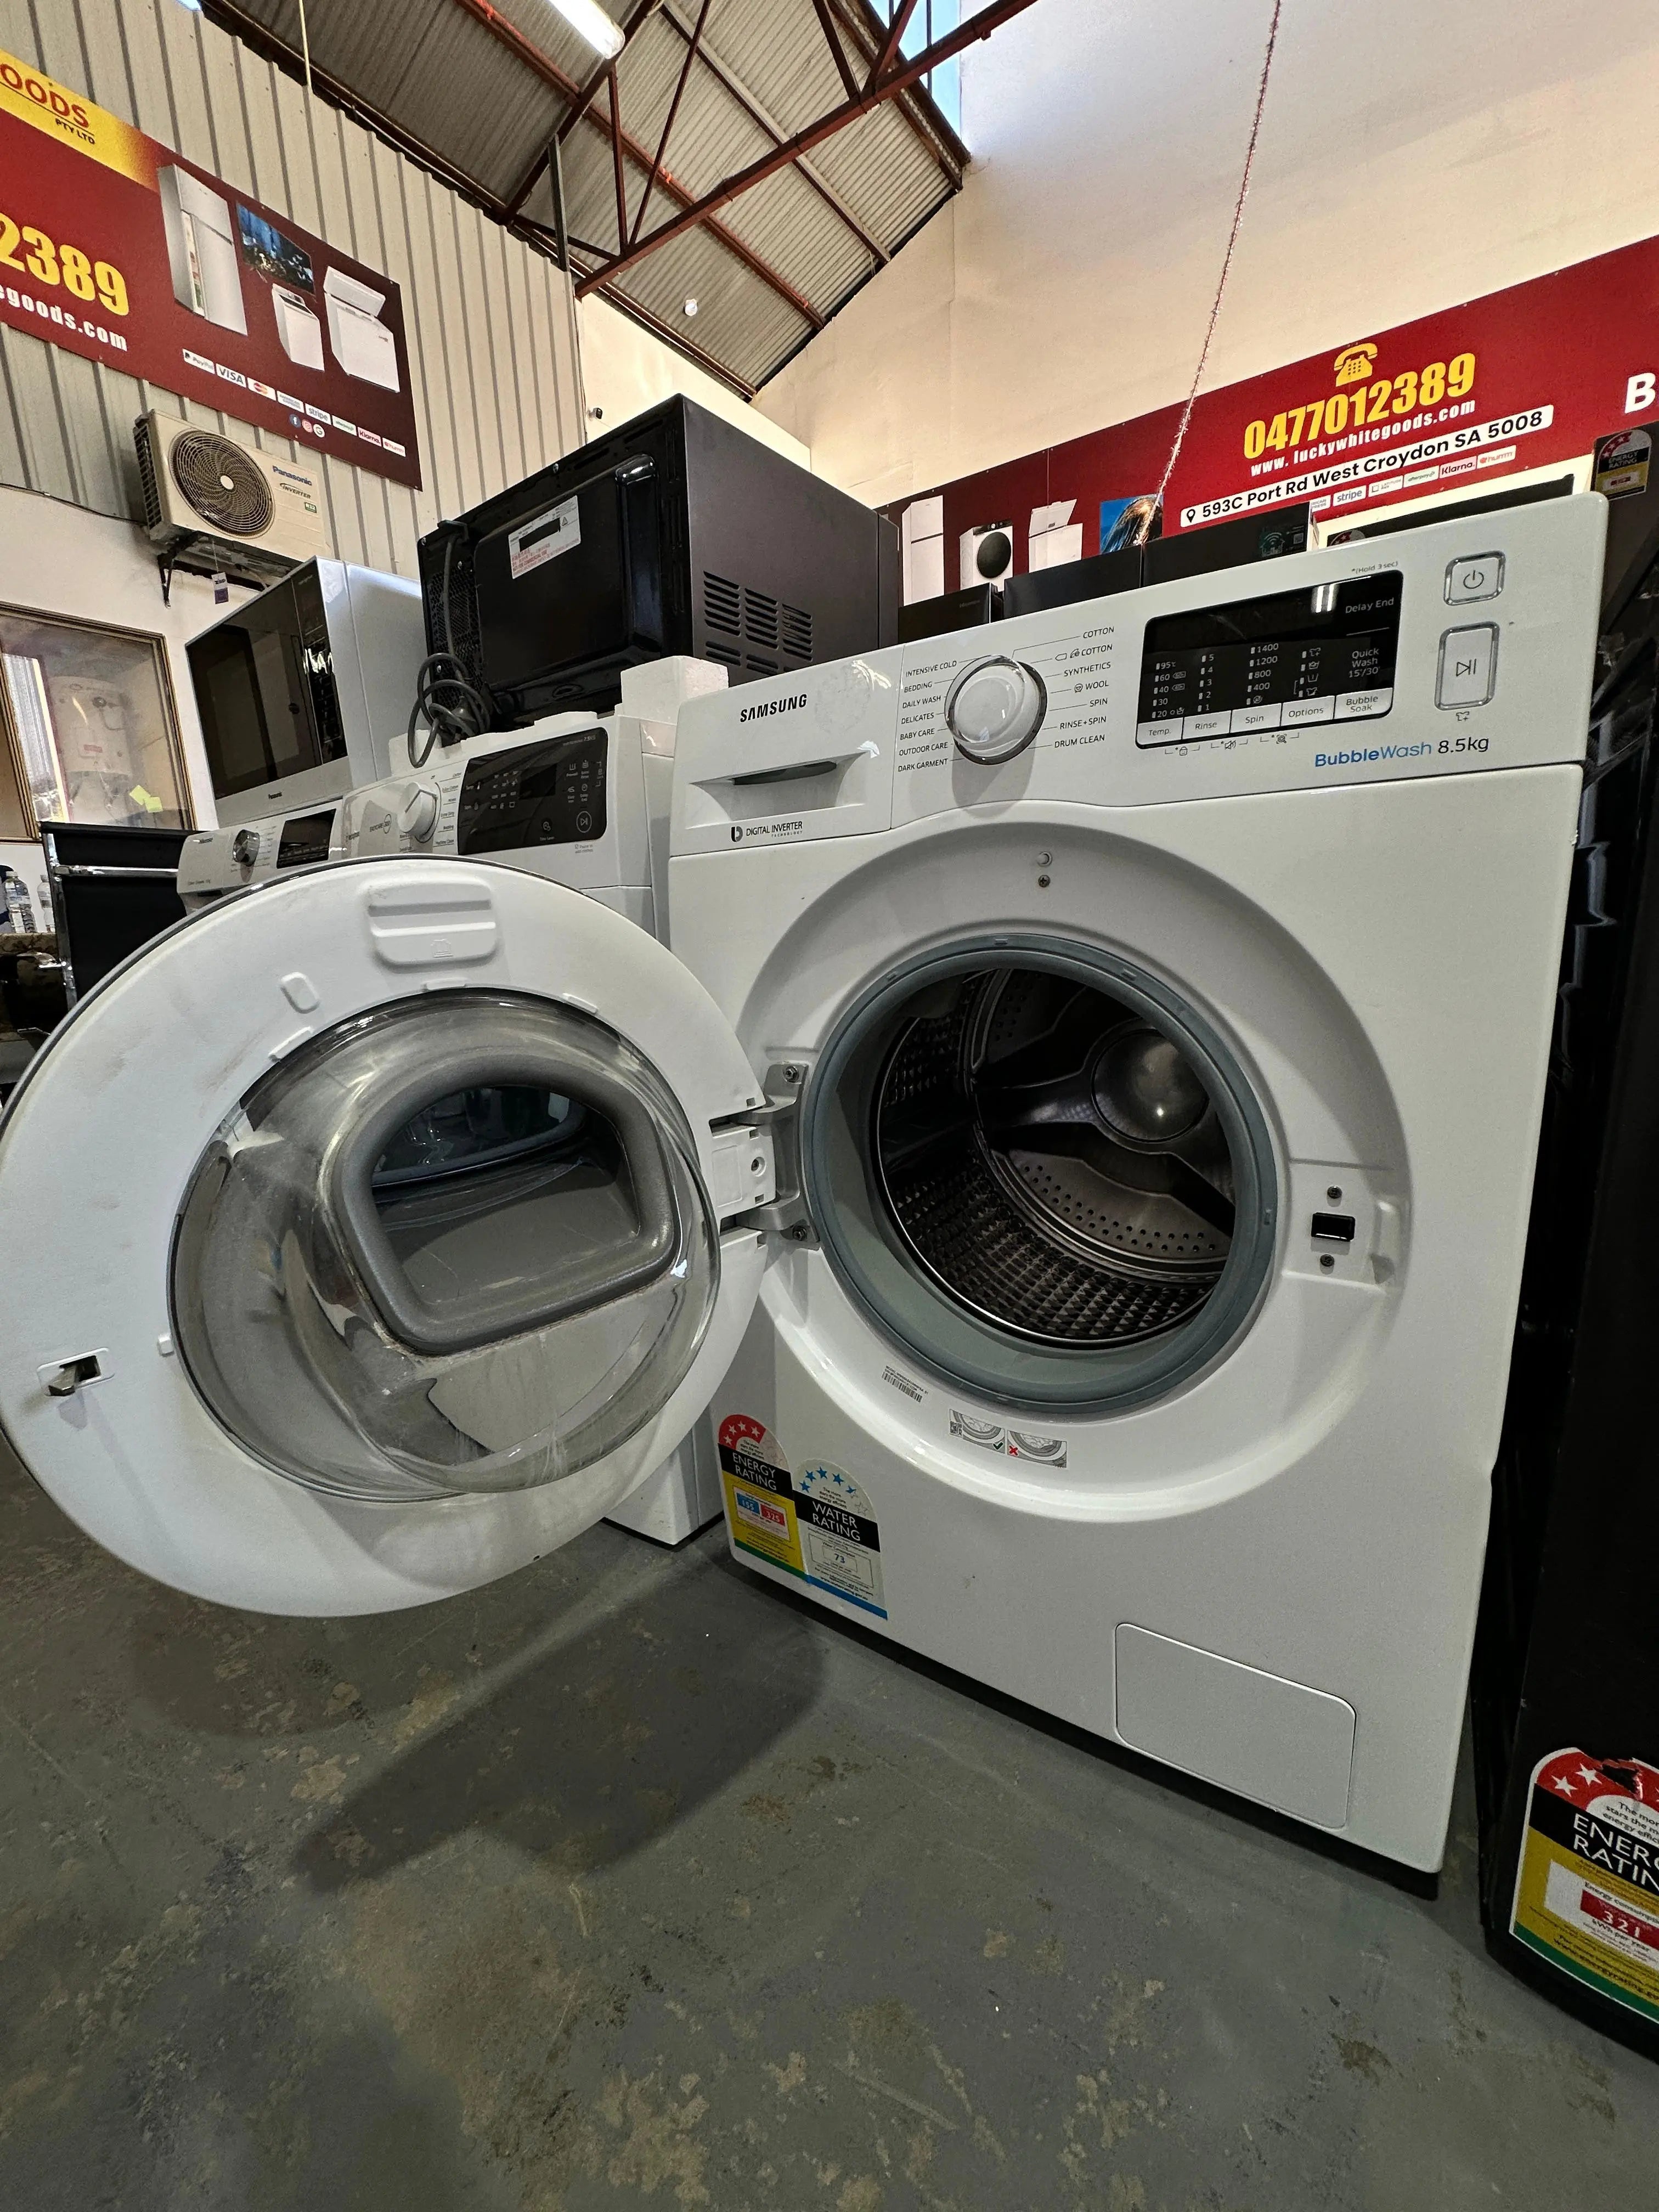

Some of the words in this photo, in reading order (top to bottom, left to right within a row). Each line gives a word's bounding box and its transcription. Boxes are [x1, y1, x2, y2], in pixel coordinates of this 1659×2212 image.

[1, 63, 89, 128] OODS
[55, 119, 74, 134] PTY
[77, 128, 95, 144] LTD
[219, 368, 244, 385] VISA
[1624, 373, 1656, 414] B
[1244, 352, 1476, 459] 0477012389
[308, 407, 329, 422] stripe
[1294, 400, 1476, 465] luckywhitegoods.com
[1203, 497, 1243, 518] 593C
[1248, 486, 1282, 505] Port
[1285, 477, 1307, 495] Rd
[1313, 462, 1359, 487] West
[1364, 439, 1449, 470] Croydon
[1455, 430, 1481, 448] SA
[1488, 410, 1543, 439] 5008
[1608, 450, 1639, 464] ENERGY
[1609, 458, 1638, 470] RATING
[272, 465, 313, 486] Panasonic
[282, 484, 311, 499] INVERTER
[1336, 488, 1362, 503] stripe
[1345, 603, 1373, 614] Delay
[1375, 597, 1395, 608] End
[1083, 626, 1114, 639] COTTON
[1081, 644, 1113, 656] COTTON
[1256, 643, 1279, 653] 1400
[1352, 648, 1380, 660] Quick
[1256, 656, 1278, 666] 1200
[1352, 657, 1378, 668] Wash
[906, 664, 938, 677] INTENSIVE
[940, 660, 957, 670] COLD
[1064, 661, 1111, 677] SYNTHETICS
[1254, 669, 1271, 679] 800
[904, 681, 933, 693] BEDDING
[1085, 680, 1109, 690] WOOL
[1253, 682, 1271, 691] 400
[902, 699, 921, 709] DAILY
[922, 695, 941, 705] WASH
[1090, 698, 1108, 707] SPIN
[1346, 695, 1379, 706] Bubble
[740, 693, 808, 723] SAMSUNG
[1289, 706, 1324, 718] Options
[1350, 704, 1373, 713] Soak
[901, 712, 934, 724] DELICATES
[1245, 715, 1264, 724] Spin
[1195, 721, 1217, 730] Rinse
[900, 731, 917, 740] BABY
[918, 728, 935, 737] CARE
[1148, 729, 1171, 737] Temp.
[1054, 738, 1077, 748] DRUM
[1079, 734, 1105, 744] CLEAN
[899, 744, 930, 756] OUTDOOR
[931, 742, 949, 751] CARE
[1315, 741, 1432, 767] BubbleWash
[1437, 736, 1489, 754] 8.5kg
[898, 763, 915, 772] DARK
[917, 758, 949, 769] GARMENT
[746, 826, 770, 837] DIGITAL
[771, 821, 803, 833] INVERTER
[732, 1452, 776, 1479] ENERGY
[735, 1464, 777, 1491] RATING
[812, 1500, 857, 1529] WATER
[812, 1513, 861, 1542] RATING
[834, 1553, 845, 1564] 73
[1619, 1802, 1638, 1815] The
[1602, 1813, 1635, 1832] energy
[1606, 1805, 1628, 1820] stars
[1631, 1818, 1647, 1830] the
[1584, 1881, 1613, 1901] Energy
[1602, 1910, 1640, 1938] 321
[1592, 1918, 1613, 1933] kWh
[1615, 1932, 1629, 1942] per
[1631, 1940, 1650, 1951] year
